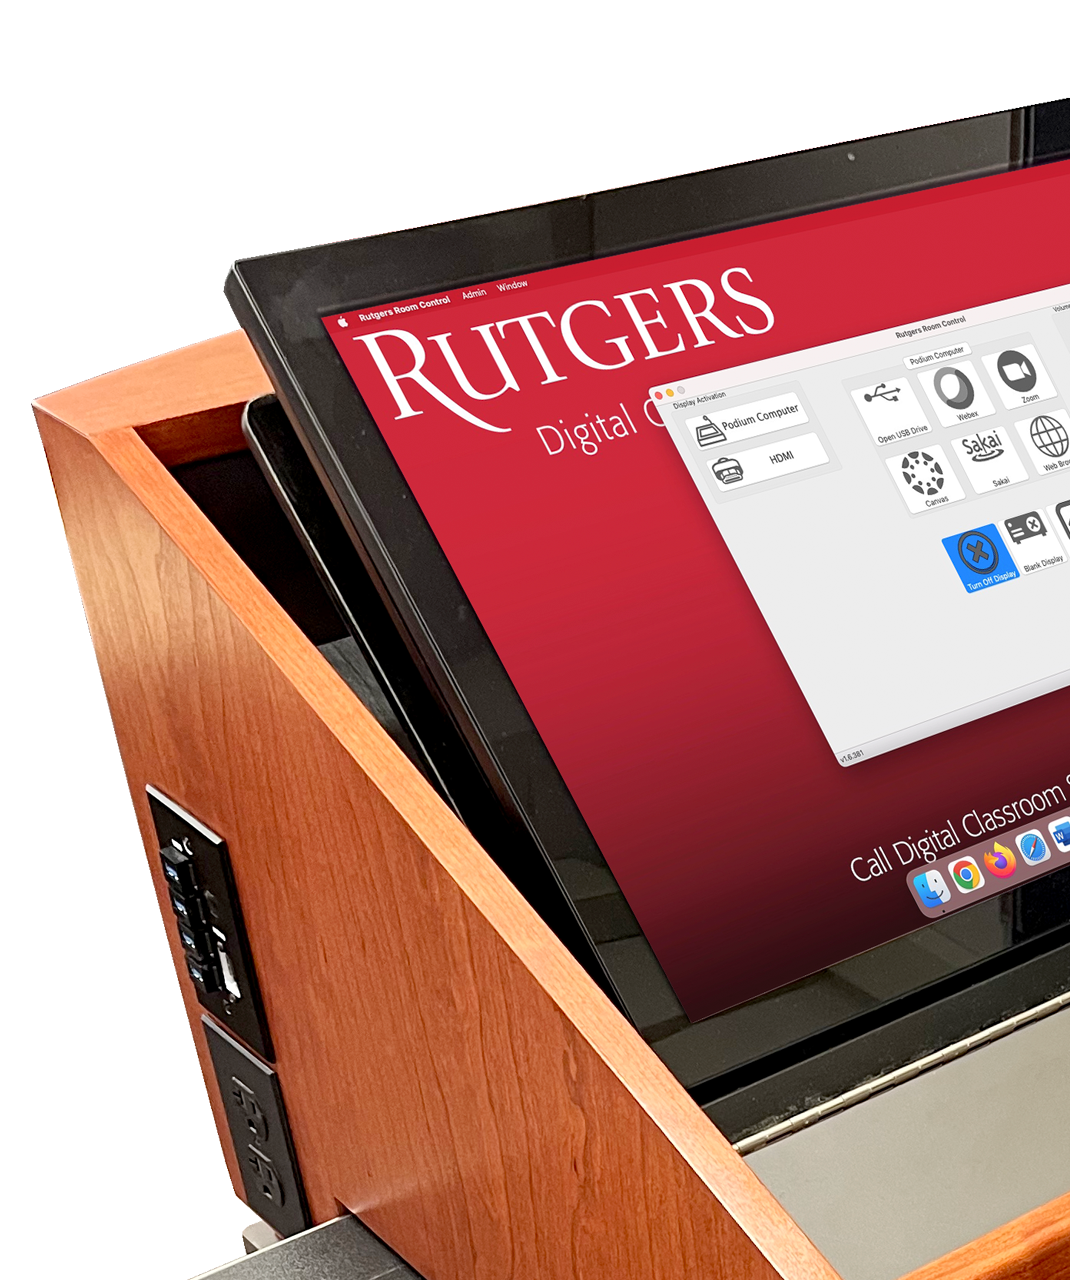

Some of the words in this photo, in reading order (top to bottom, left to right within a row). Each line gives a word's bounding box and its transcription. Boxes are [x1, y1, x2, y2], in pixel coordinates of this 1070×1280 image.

[462, 288, 487, 300] Admin
[496, 280, 528, 292] Window
[358, 309, 394, 323] Rutgers
[393, 302, 419, 315] Room
[418, 296, 451, 309] Control
[895, 324, 922, 339] Rutgers
[922, 320, 943, 334] Room
[942, 315, 967, 329] Control
[353, 266, 776, 434] RUTGERS
[909, 351, 932, 365] Podium
[933, 345, 964, 360] Computer
[673, 399, 696, 411] Display
[696, 391, 727, 404] Activation
[1022, 393, 1041, 404] Zoom
[721, 413, 756, 431] Podium
[756, 404, 799, 423] Computer
[956, 410, 980, 422] Webex
[535, 402, 638, 458] Digital
[877, 432, 897, 445] Open
[896, 428, 911, 440] USB
[910, 424, 929, 437] Drive
[961, 429, 1003, 455] Sakai
[769, 450, 795, 465] HDMI
[1043, 461, 1058, 472] Web
[992, 475, 1010, 488] Sakai
[925, 494, 950, 508] Canvas
[1023, 560, 1042, 573] Blank
[1041, 554, 1064, 569] Display
[966, 578, 983, 591] Turn
[982, 574, 994, 587] Off
[993, 569, 1017, 584] Display
[840, 749, 864, 763] v1.6.381
[850, 846, 893, 882] Call
[892, 819, 961, 864] Digital
[961, 784, 1067, 838] Classroom
[1055, 831, 1065, 842] W
